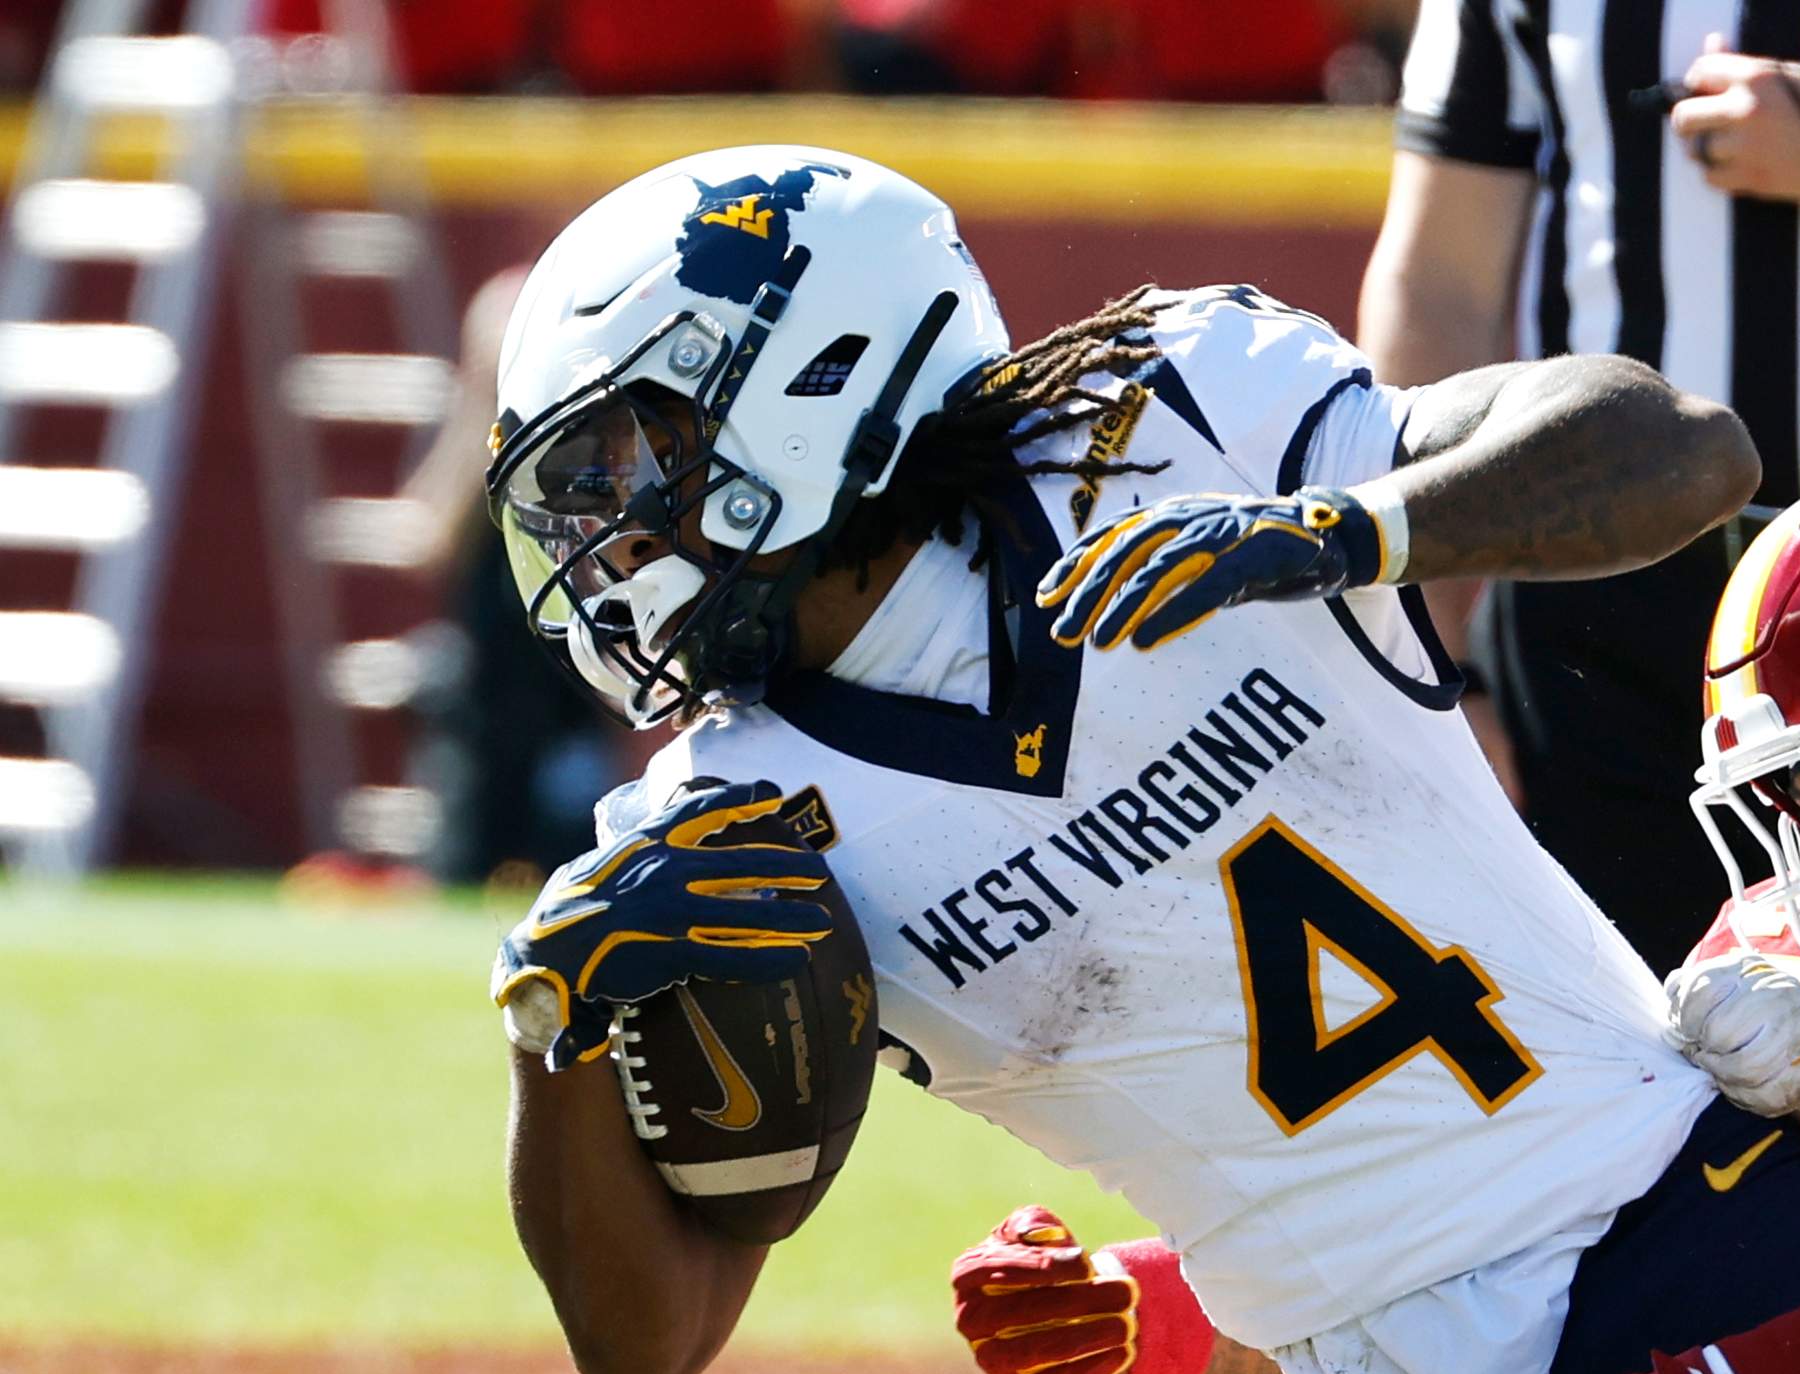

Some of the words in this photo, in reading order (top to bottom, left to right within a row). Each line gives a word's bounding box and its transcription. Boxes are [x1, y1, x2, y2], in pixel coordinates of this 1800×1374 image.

[898, 845, 1079, 989] WEST
[1047, 667, 1326, 889] VIRGINIA
[1219, 812, 1545, 1137] 4
